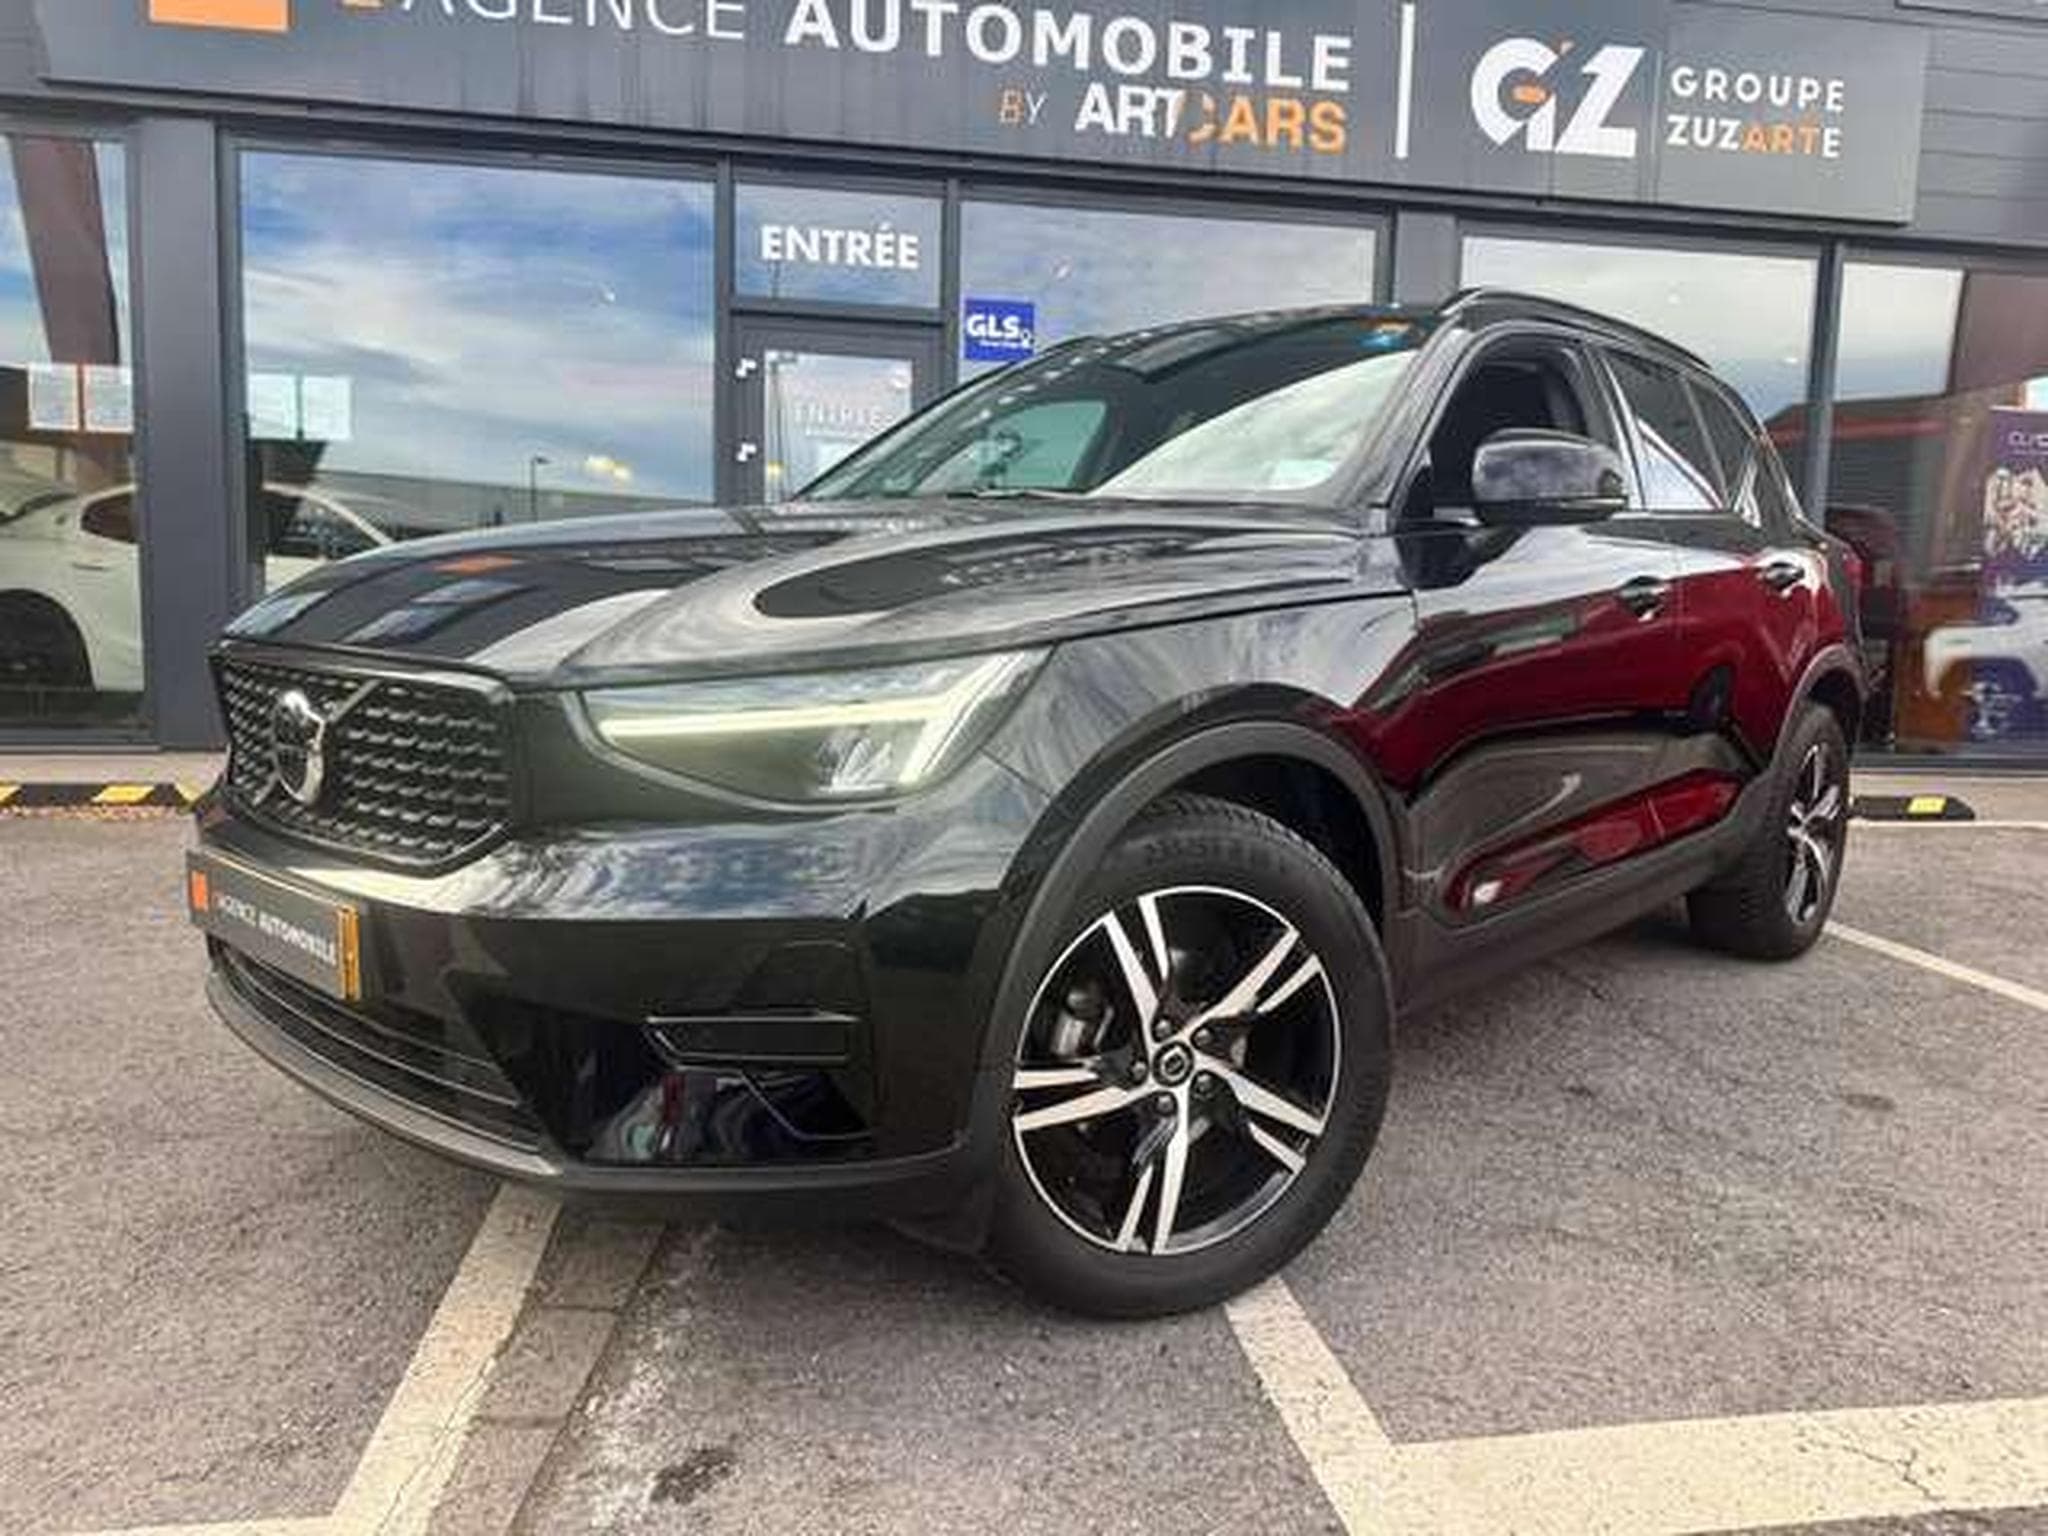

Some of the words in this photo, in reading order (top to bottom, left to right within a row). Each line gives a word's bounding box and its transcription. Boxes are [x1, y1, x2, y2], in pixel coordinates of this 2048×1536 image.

[401, 0, 745, 40] NCE
[784, 0, 1353, 93] AUTOMOBILE
[999, 88, 1047, 126] BY
[1671, 67, 1845, 112] GROUPE
[1666, 113, 1843, 158] ZUZARTE
[760, 221, 920, 270] ENTRÉE
[967, 313, 1020, 338] GLS
